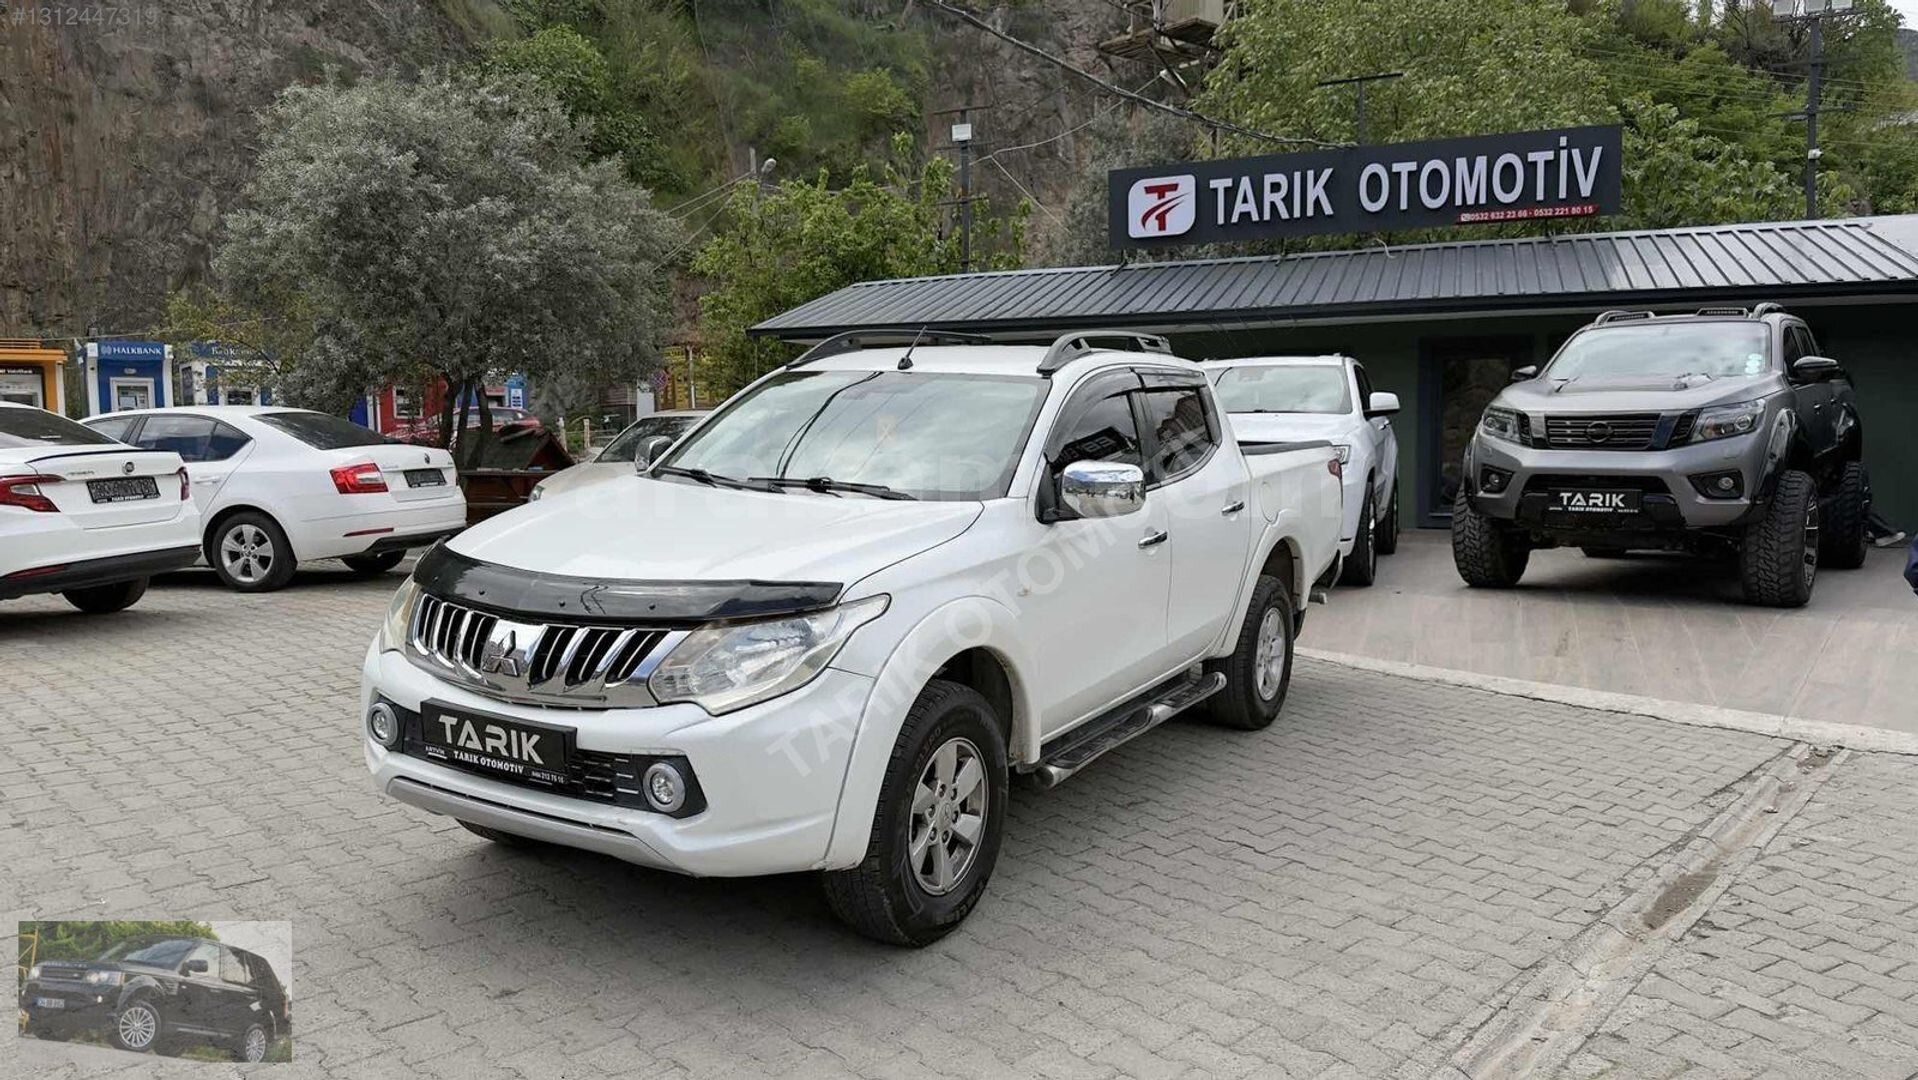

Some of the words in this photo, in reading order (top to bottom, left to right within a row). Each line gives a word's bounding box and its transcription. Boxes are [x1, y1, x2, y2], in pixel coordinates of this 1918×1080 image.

[1209, 167, 1335, 226] TARIK
[1358, 135, 1604, 214] OTOMOTİV
[1559, 492, 1625, 508] TARIK
[438, 714, 544, 765] TARIK
[453, 750, 480, 765] TARIK
